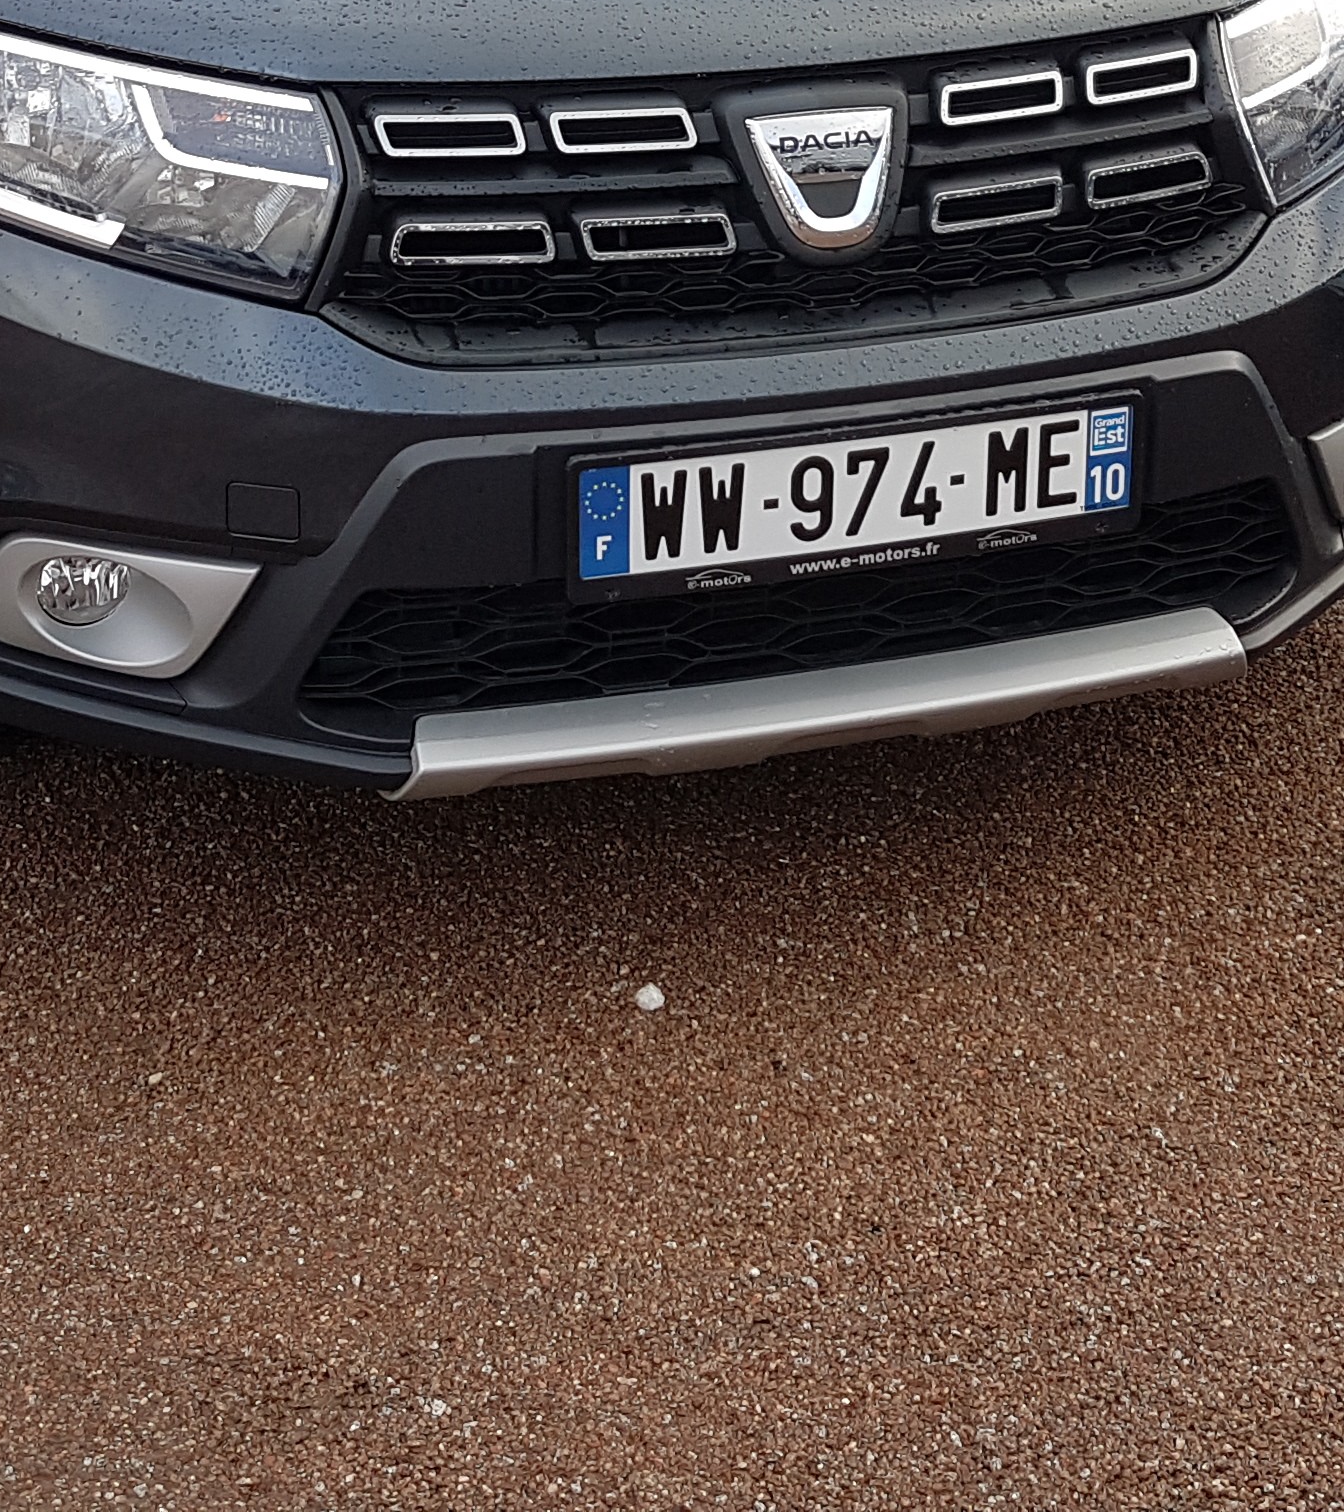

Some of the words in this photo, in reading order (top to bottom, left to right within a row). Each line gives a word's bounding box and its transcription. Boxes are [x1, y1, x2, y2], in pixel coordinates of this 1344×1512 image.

[778, 129, 876, 155] DACIA
[1094, 414, 1126, 428] Grand
[1093, 425, 1125, 446] Est
[1090, 462, 1126, 504] 10
[595, 535, 613, 561] F
[789, 541, 941, 576] www.e-motors.fr
